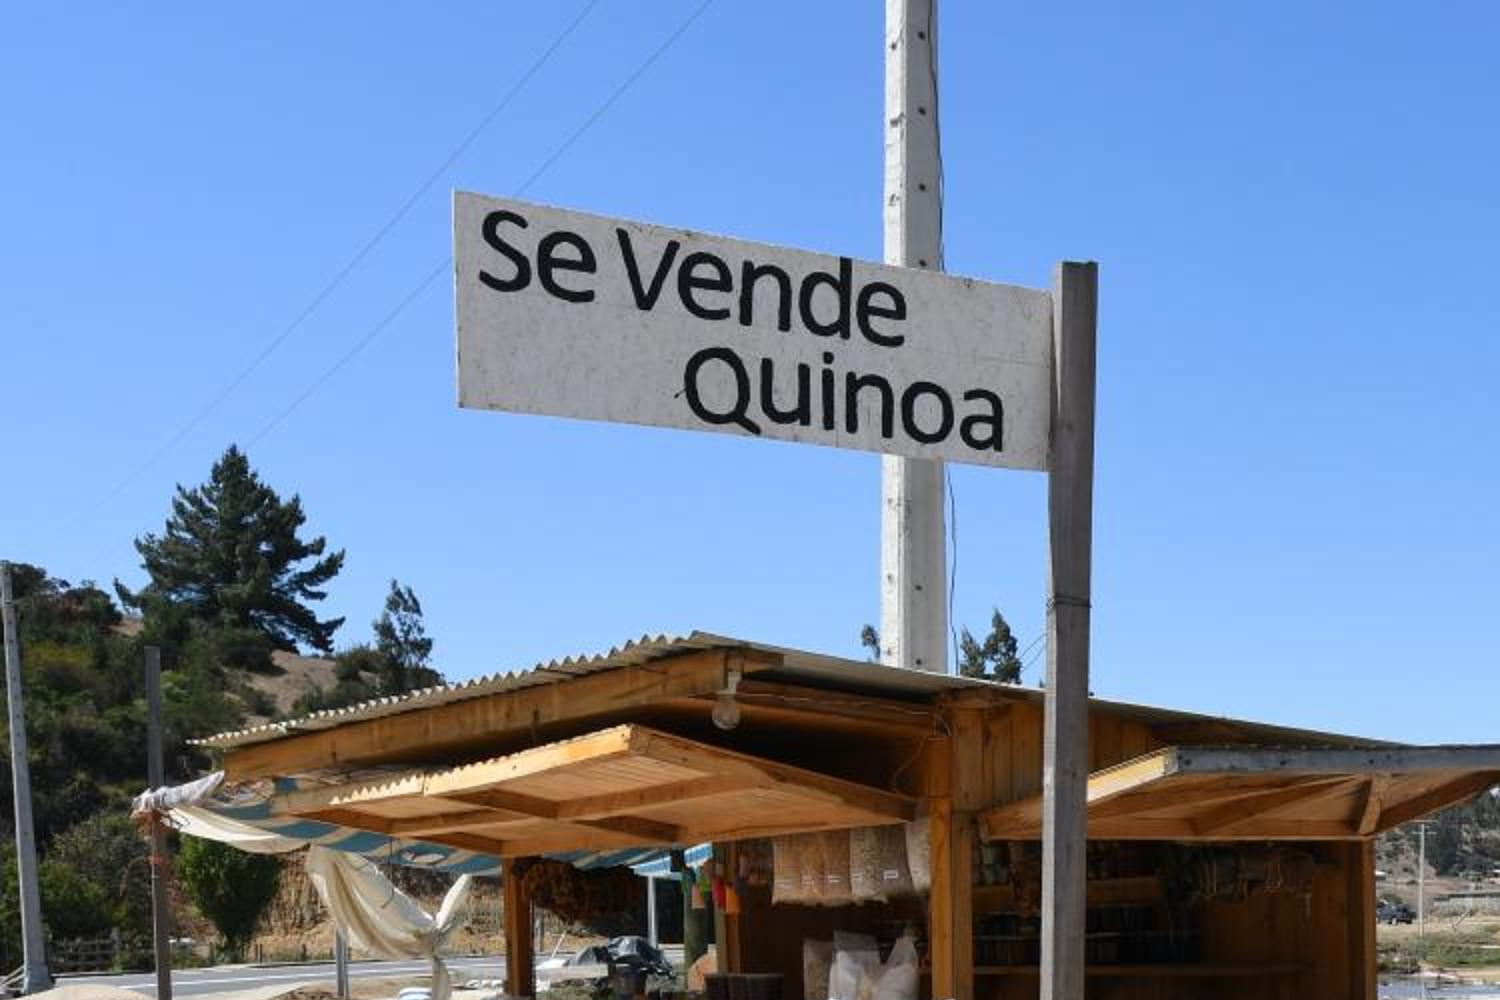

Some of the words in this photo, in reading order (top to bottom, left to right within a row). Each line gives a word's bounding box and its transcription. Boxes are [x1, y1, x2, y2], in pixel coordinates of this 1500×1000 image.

[478, 209, 597, 303] Se
[615, 226, 908, 347] Vende
[683, 346, 1005, 453] Quinoa
